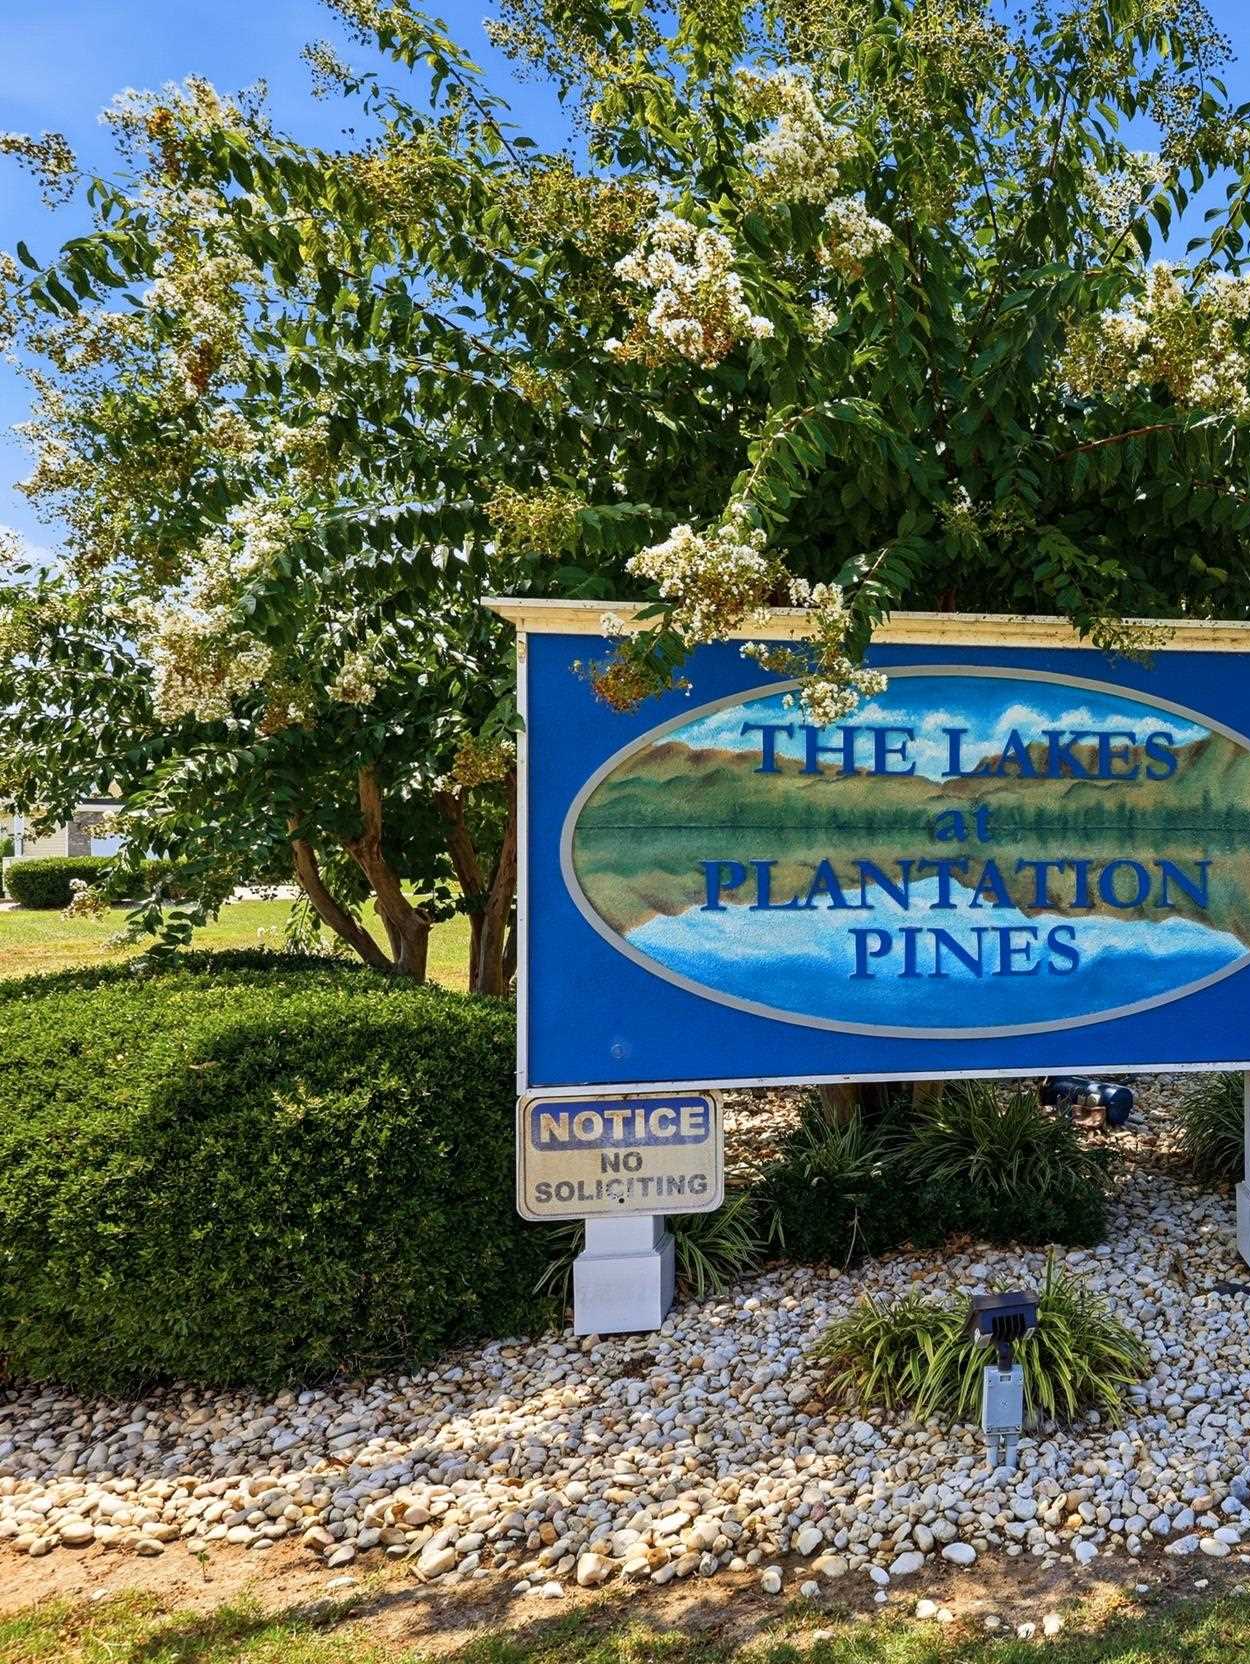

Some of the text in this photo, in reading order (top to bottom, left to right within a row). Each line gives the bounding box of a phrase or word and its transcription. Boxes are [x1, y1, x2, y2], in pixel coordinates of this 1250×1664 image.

[740, 722, 1179, 780] THE LAKES
[934, 803, 992, 844] at
[700, 858, 1213, 912] PLANTATION
[849, 924, 1081, 980] PINES
[540, 1106, 705, 1143] NOTICE
[600, 1151, 643, 1173] NO
[535, 1173, 708, 1203] SOLICITING
